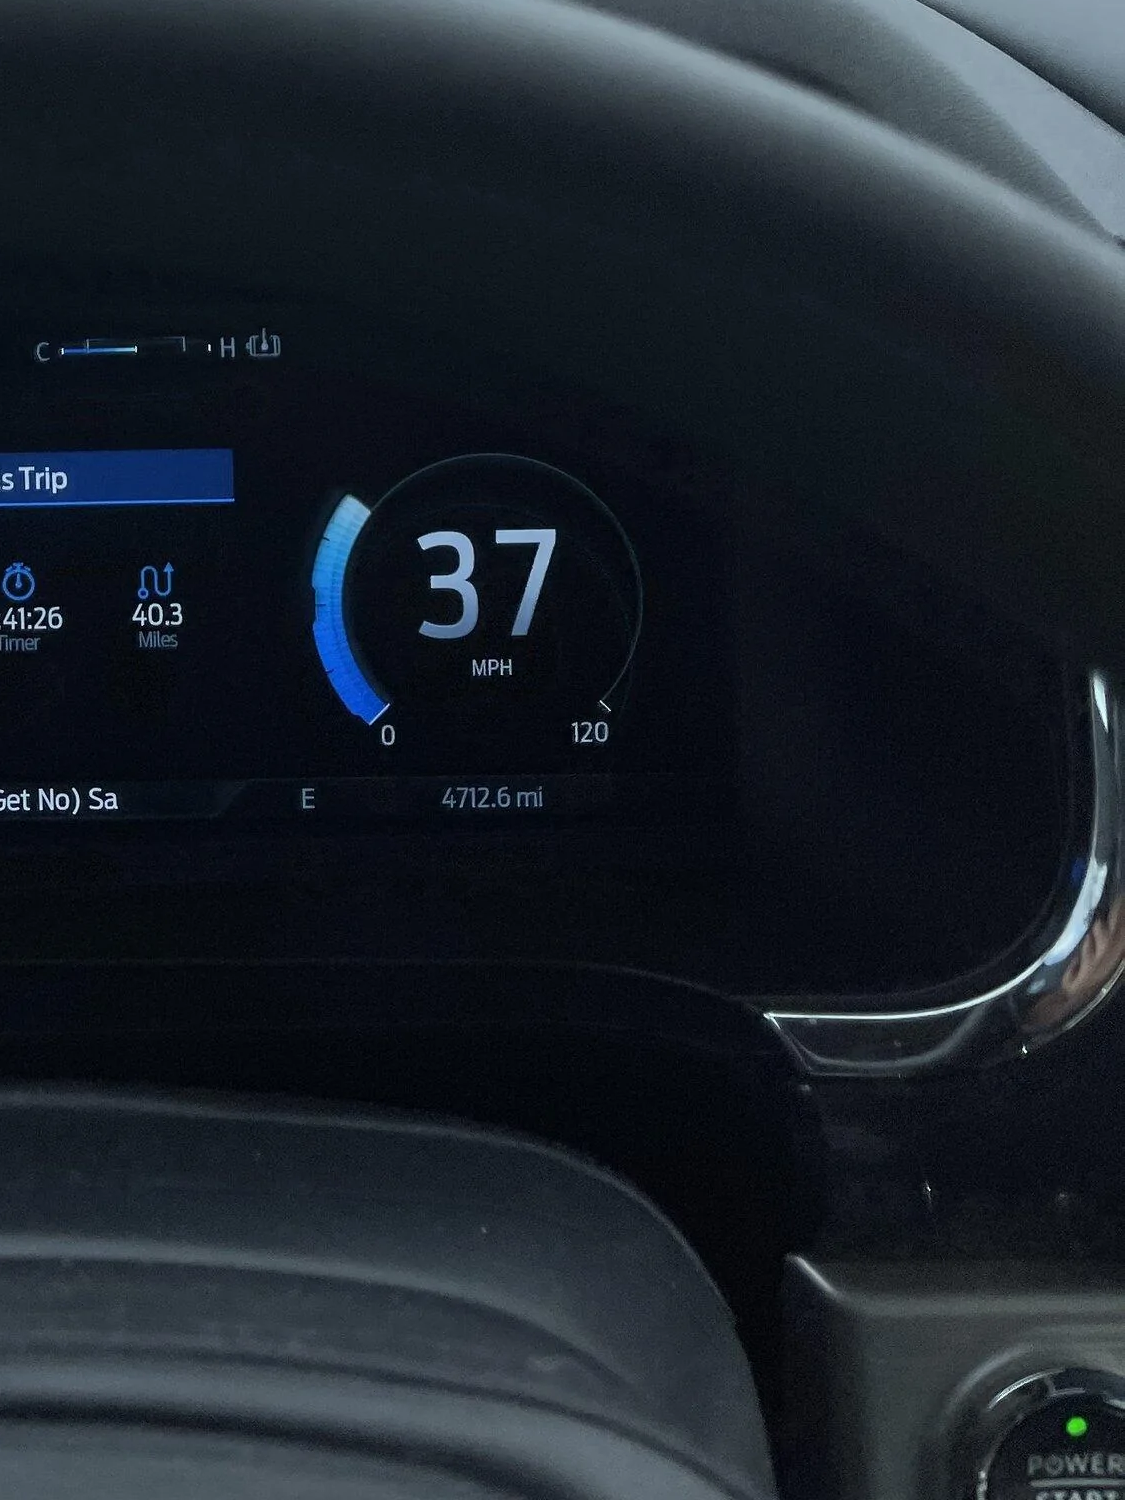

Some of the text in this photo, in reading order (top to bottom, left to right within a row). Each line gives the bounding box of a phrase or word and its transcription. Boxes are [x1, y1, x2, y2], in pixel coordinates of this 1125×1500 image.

[35, 341, 50, 362] C
[220, 336, 236, 358] H
[18, 465, 68, 494] Trip
[417, 528, 557, 639] 37
[131, 602, 183, 627] 40.3
[138, 630, 179, 649] Miles
[472, 658, 513, 677] MPH
[381, 724, 396, 746] 0
[571, 721, 609, 744] 120
[38, 787, 81, 815] No)
[88, 787, 119, 811] Sa
[301, 787, 316, 810] E
[441, 785, 544, 809] 4712.6 mi
[1027, 1452, 1125, 1476] POWER
